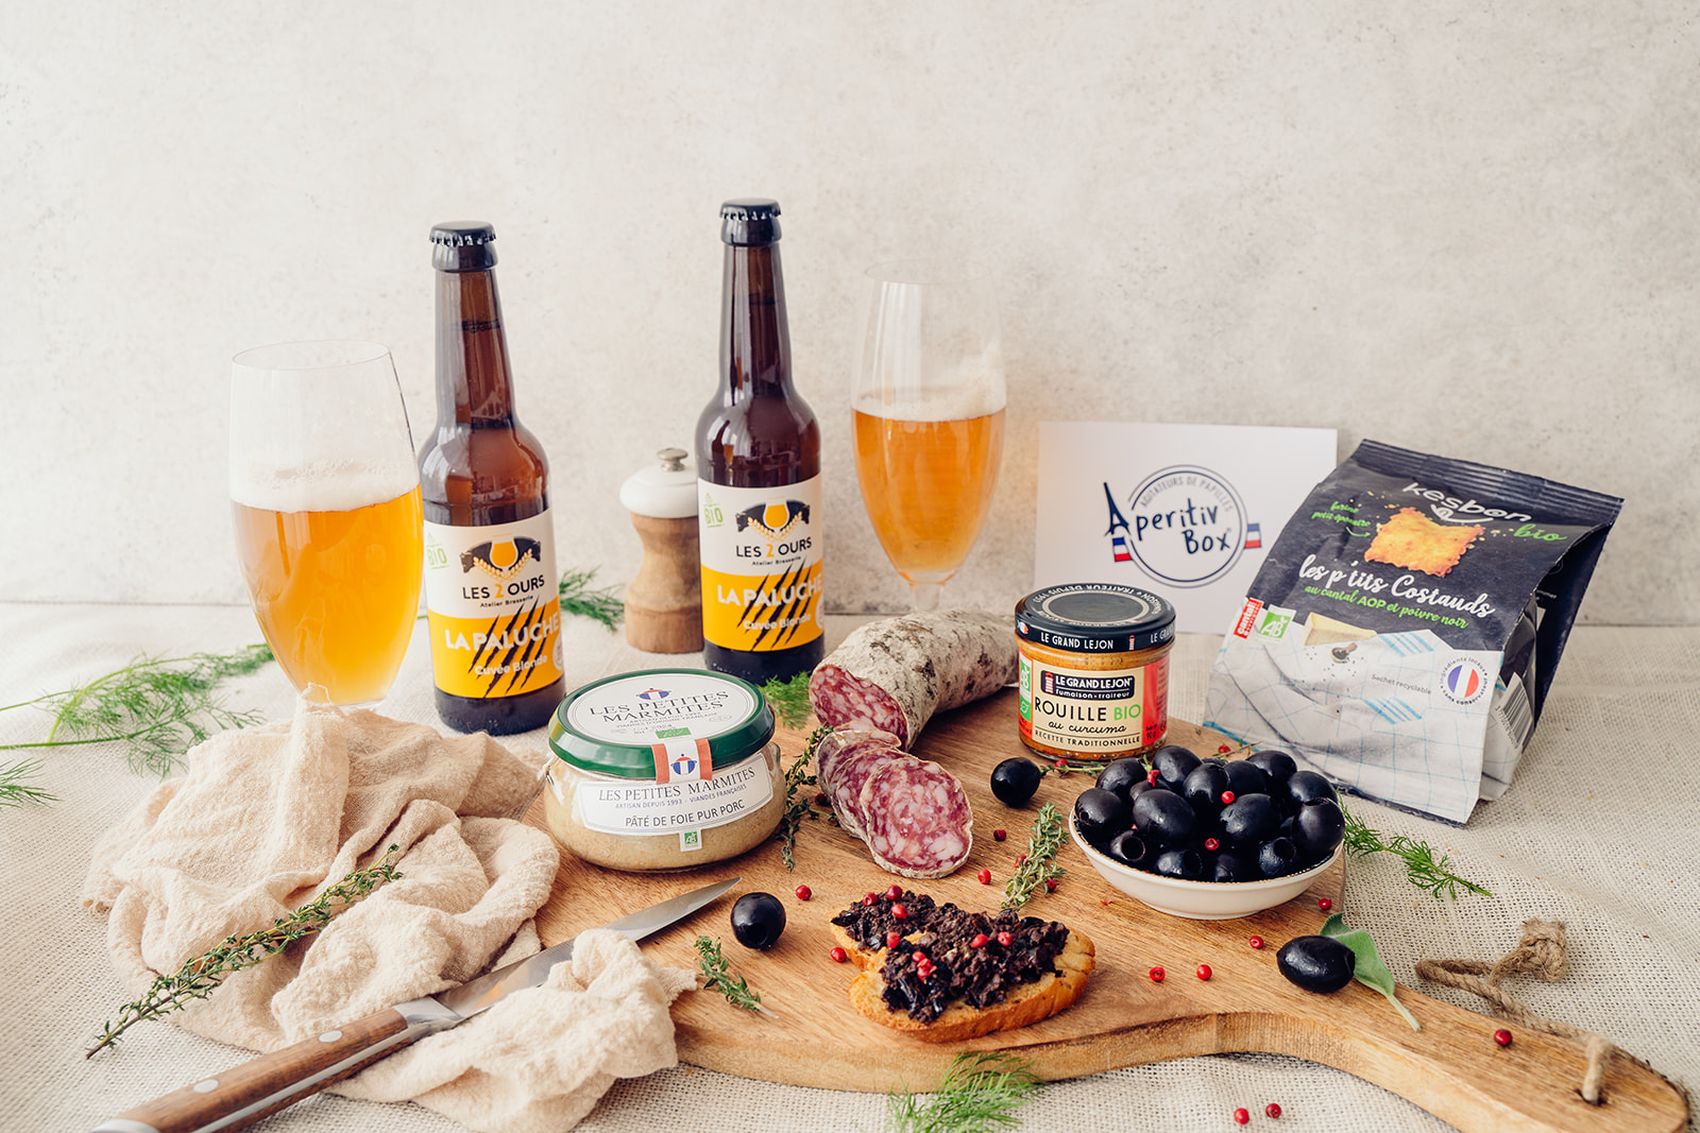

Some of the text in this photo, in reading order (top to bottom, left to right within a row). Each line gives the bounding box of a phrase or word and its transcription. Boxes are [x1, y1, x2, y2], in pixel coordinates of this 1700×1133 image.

[1402, 482, 1532, 522] kesbon
[1181, 529, 1230, 554] Box
[1513, 523, 1568, 542] bio
[736, 536, 812, 558] LES 2 OURS
[462, 574, 545, 599] LES 2 OURS
[717, 584, 741, 606] LA
[1299, 554, 1330, 581] les
[1391, 574, 1496, 618] Costauds
[1321, 588, 1359, 604] cantal
[1358, 596, 1387, 608] AOP
[1387, 603, 1401, 613] et
[1399, 606, 1441, 621] poivre
[1440, 616, 1469, 629] noir
[445, 612, 560, 651] LA PALUCHE
[1041, 632, 1114, 650] LE GRAND LEJON
[1150, 632, 1158, 644] LE
[474, 664, 511, 676] Cuvée
[512, 654, 548, 672] Blonde
[1055, 676, 1131, 689] LE GRAND LEJON
[1056, 688, 1130, 699] fumaison traiteur
[590, 690, 729, 715] LES PETITES
[603, 700, 723, 722] MARMITES
[1034, 696, 1142, 722] ROUILLE BIO
[1035, 730, 1140, 747] RECETTE TRADITIONNELLE
[1048, 721, 1127, 734] au curcuma
[599, 766, 756, 801] LES PETITES MARMITES
[625, 800, 745, 828] PÂTÉ DE FOIE PUR PORC
